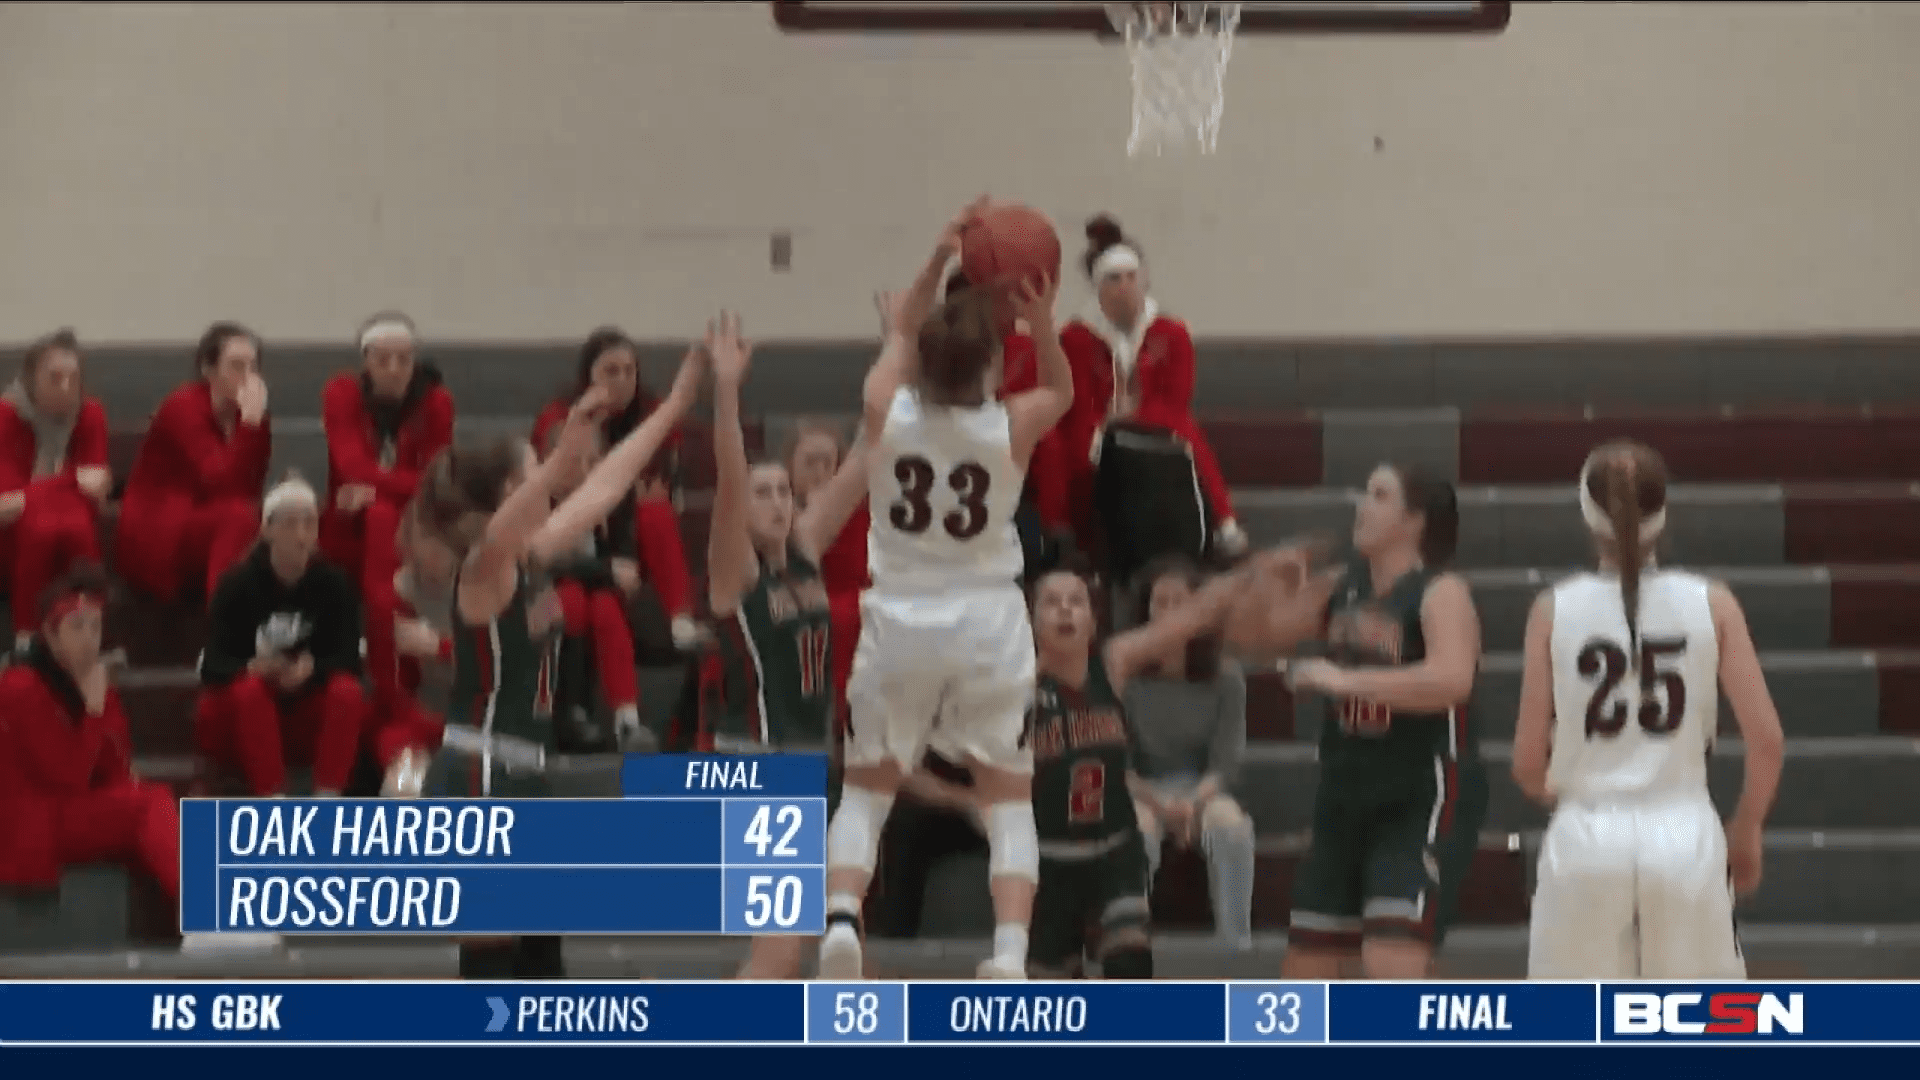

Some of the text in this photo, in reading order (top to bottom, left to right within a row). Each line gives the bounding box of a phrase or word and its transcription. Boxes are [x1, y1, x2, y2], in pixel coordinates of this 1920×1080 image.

[888, 454, 992, 541] 33
[1576, 634, 1688, 741] 25
[1067, 760, 1105, 824] 2
